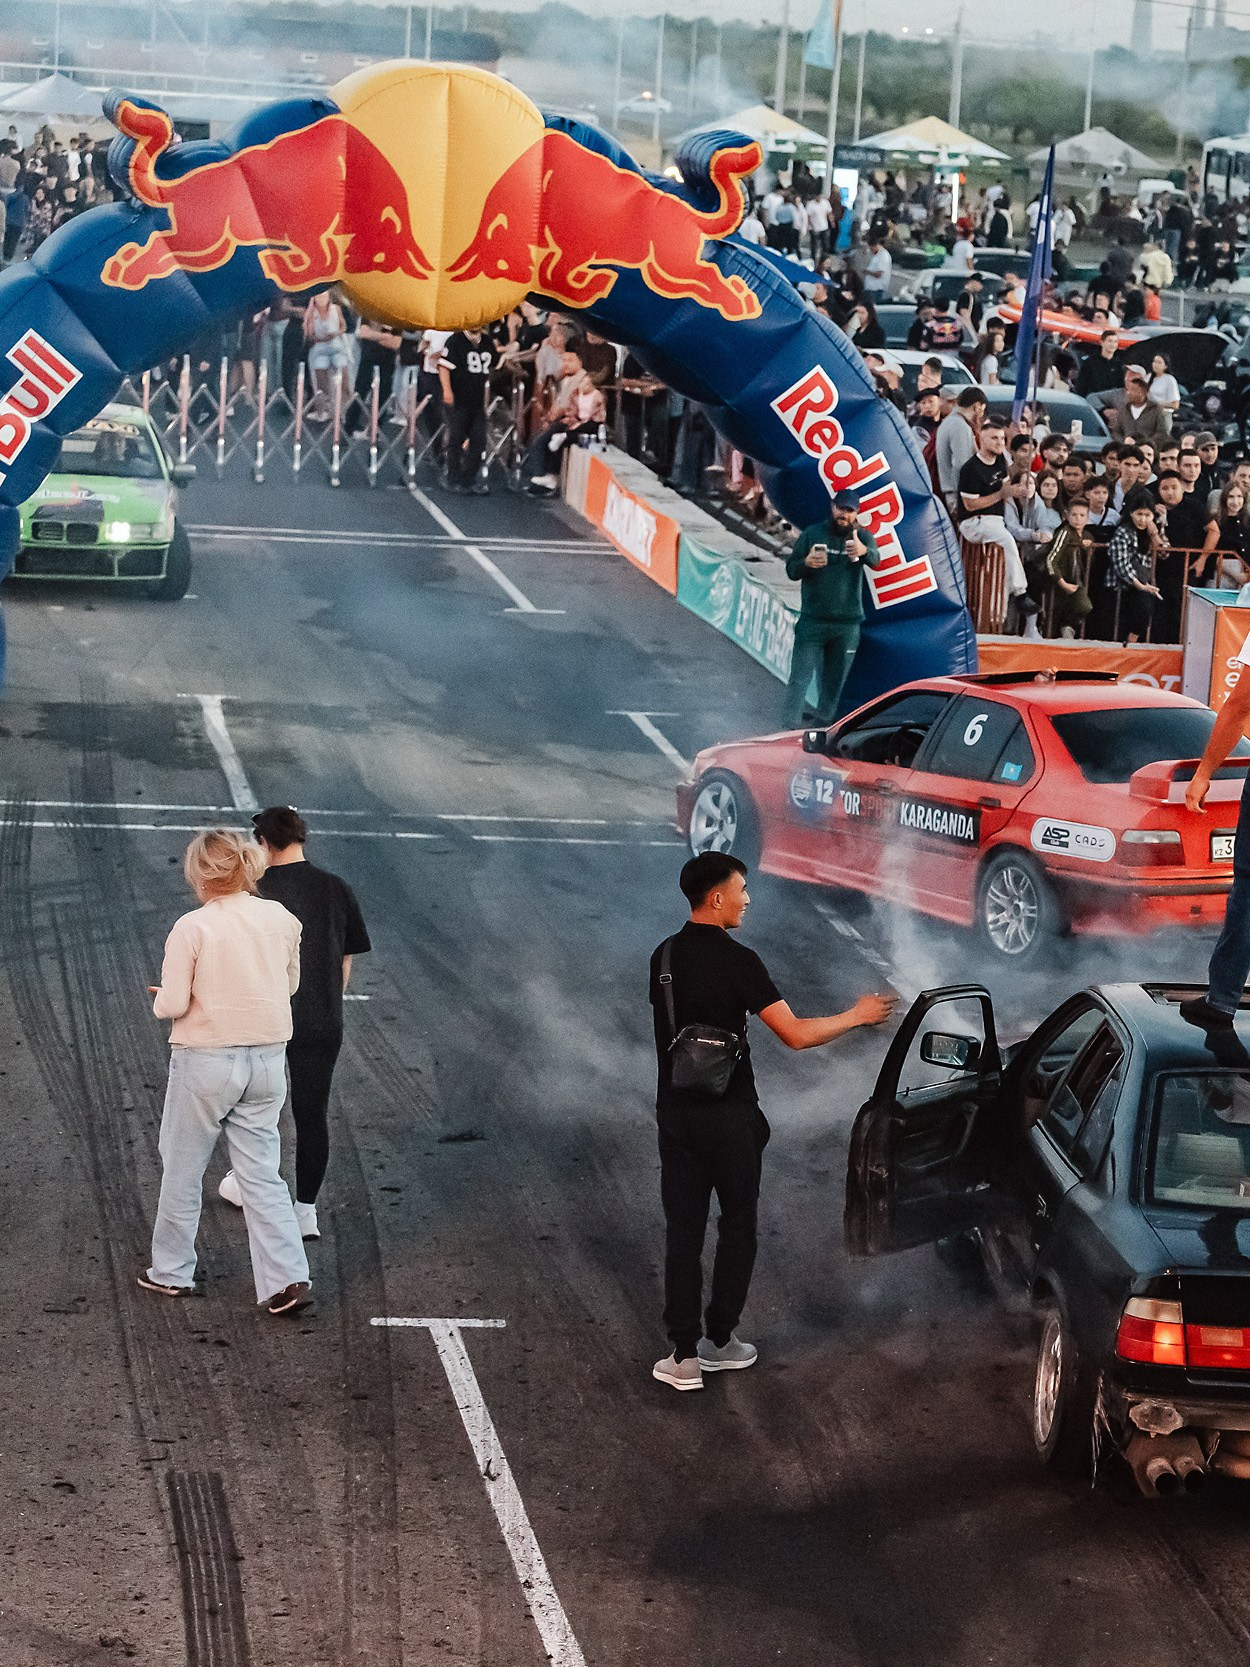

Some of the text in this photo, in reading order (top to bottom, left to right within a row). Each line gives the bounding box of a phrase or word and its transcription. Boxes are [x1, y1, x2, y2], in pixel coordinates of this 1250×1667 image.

[770, 364, 939, 610] Red Bull
[963, 713, 989, 746] 6
[815, 779, 834, 804] 12
[900, 801, 975, 840] KARAGANDA
[1043, 826, 1070, 840] ASP
